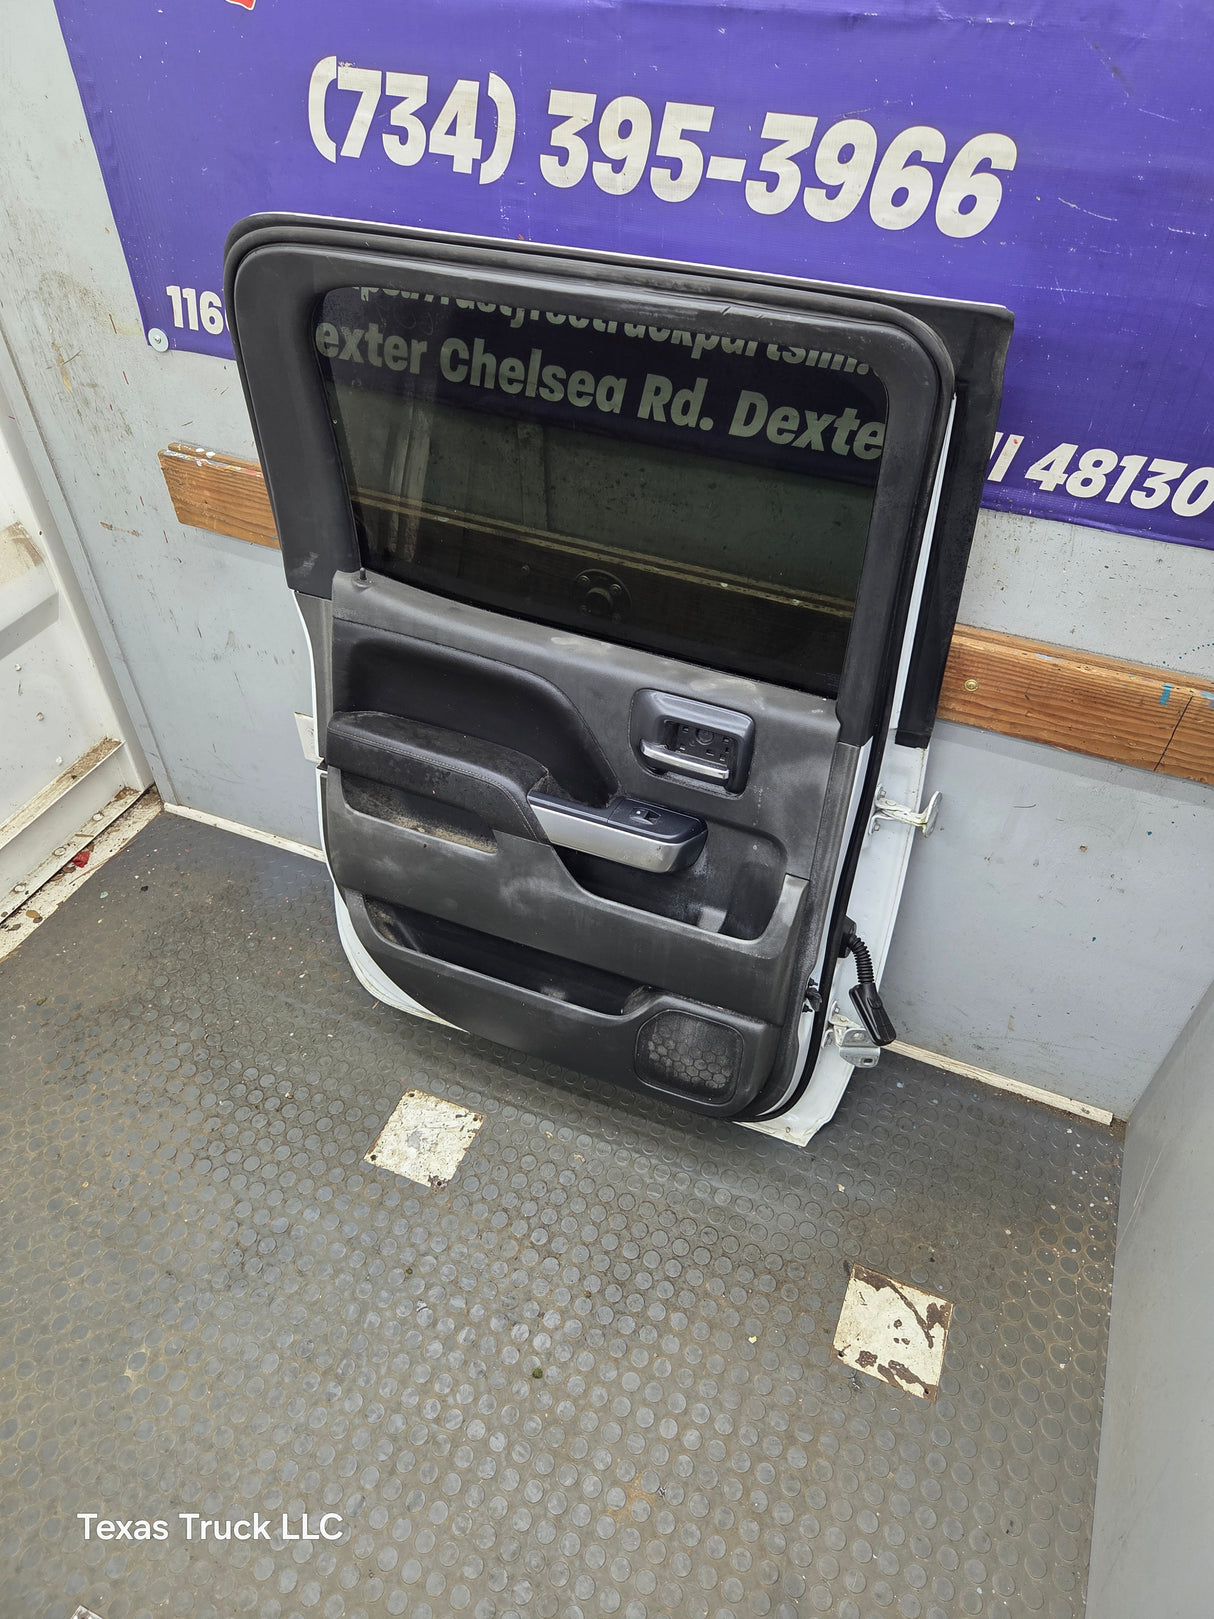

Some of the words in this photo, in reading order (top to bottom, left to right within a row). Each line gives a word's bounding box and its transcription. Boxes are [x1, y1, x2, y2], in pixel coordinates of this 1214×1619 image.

[308, 55, 516, 185] (734)
[539, 89, 1018, 239] 395-3966
[165, 285, 230, 335] 116
[315, 322, 427, 375] exter
[440, 337, 627, 414] Chelsea
[637, 373, 714, 431] Rd.
[728, 390, 886, 460] Dexte
[1025, 443, 1214, 518] 48130
